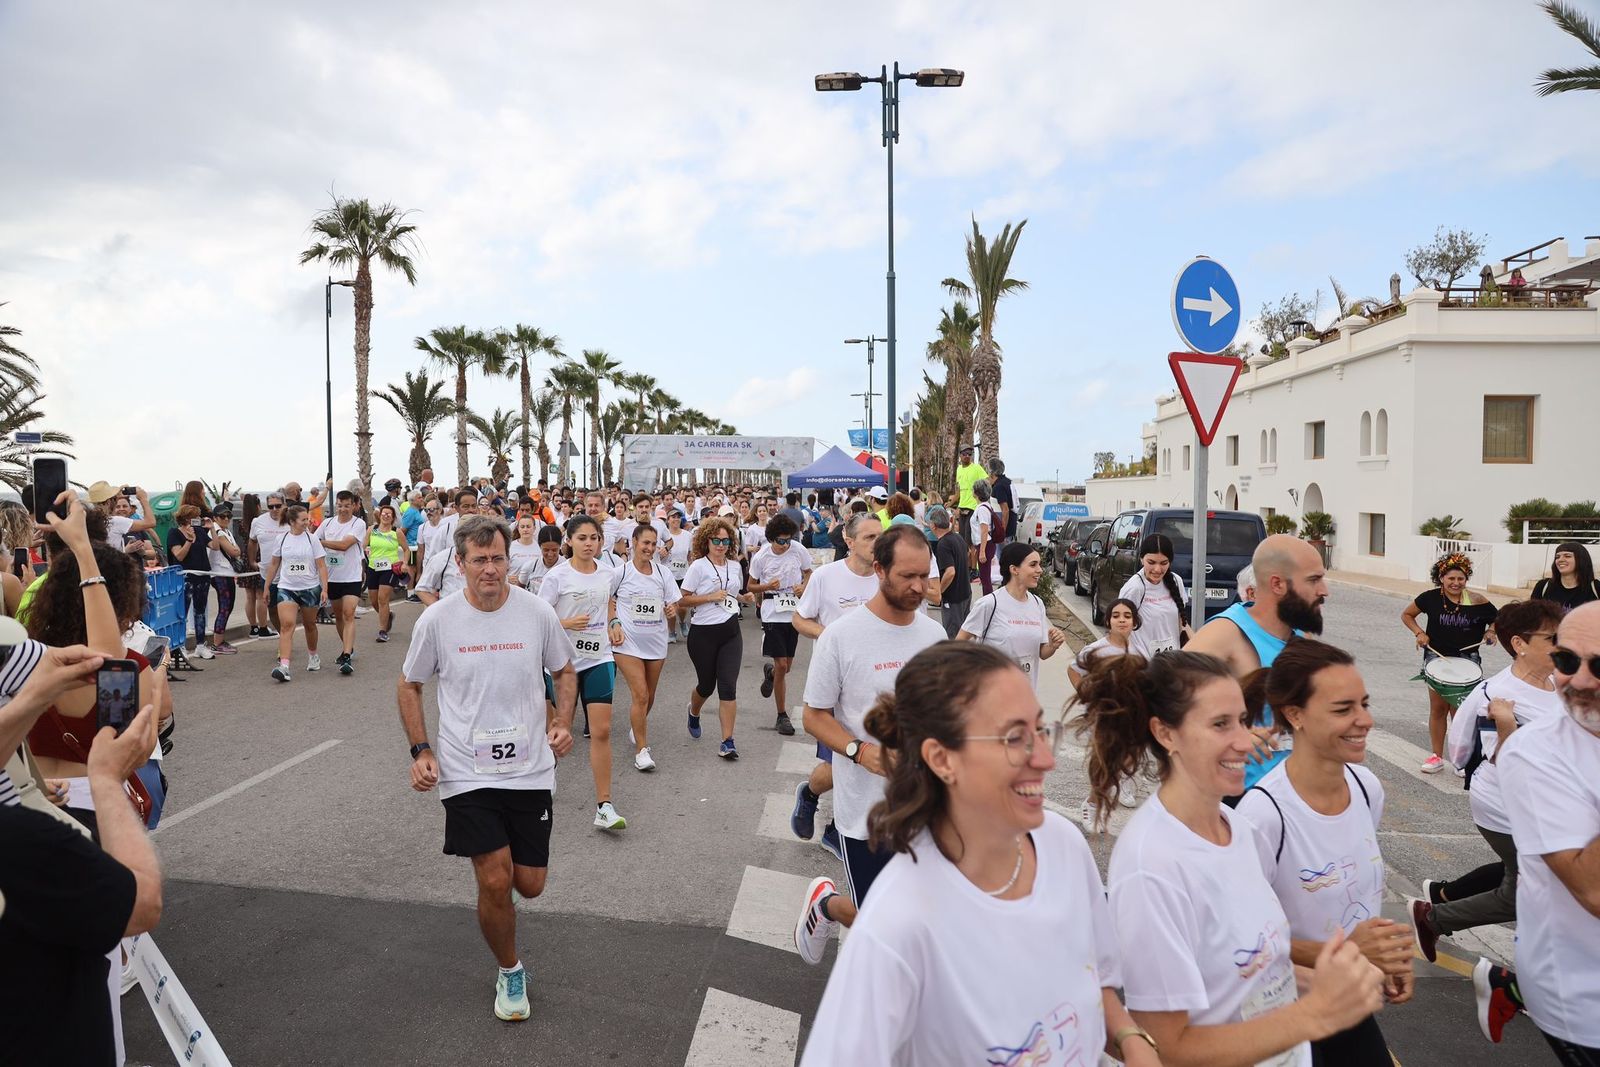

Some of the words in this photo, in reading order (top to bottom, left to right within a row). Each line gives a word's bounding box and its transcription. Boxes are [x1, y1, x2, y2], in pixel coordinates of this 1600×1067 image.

[636, 604, 655, 613] 394
[490, 643, 498, 651] NO
[576, 639, 600, 651] 868
[492, 742, 516, 760] 52
